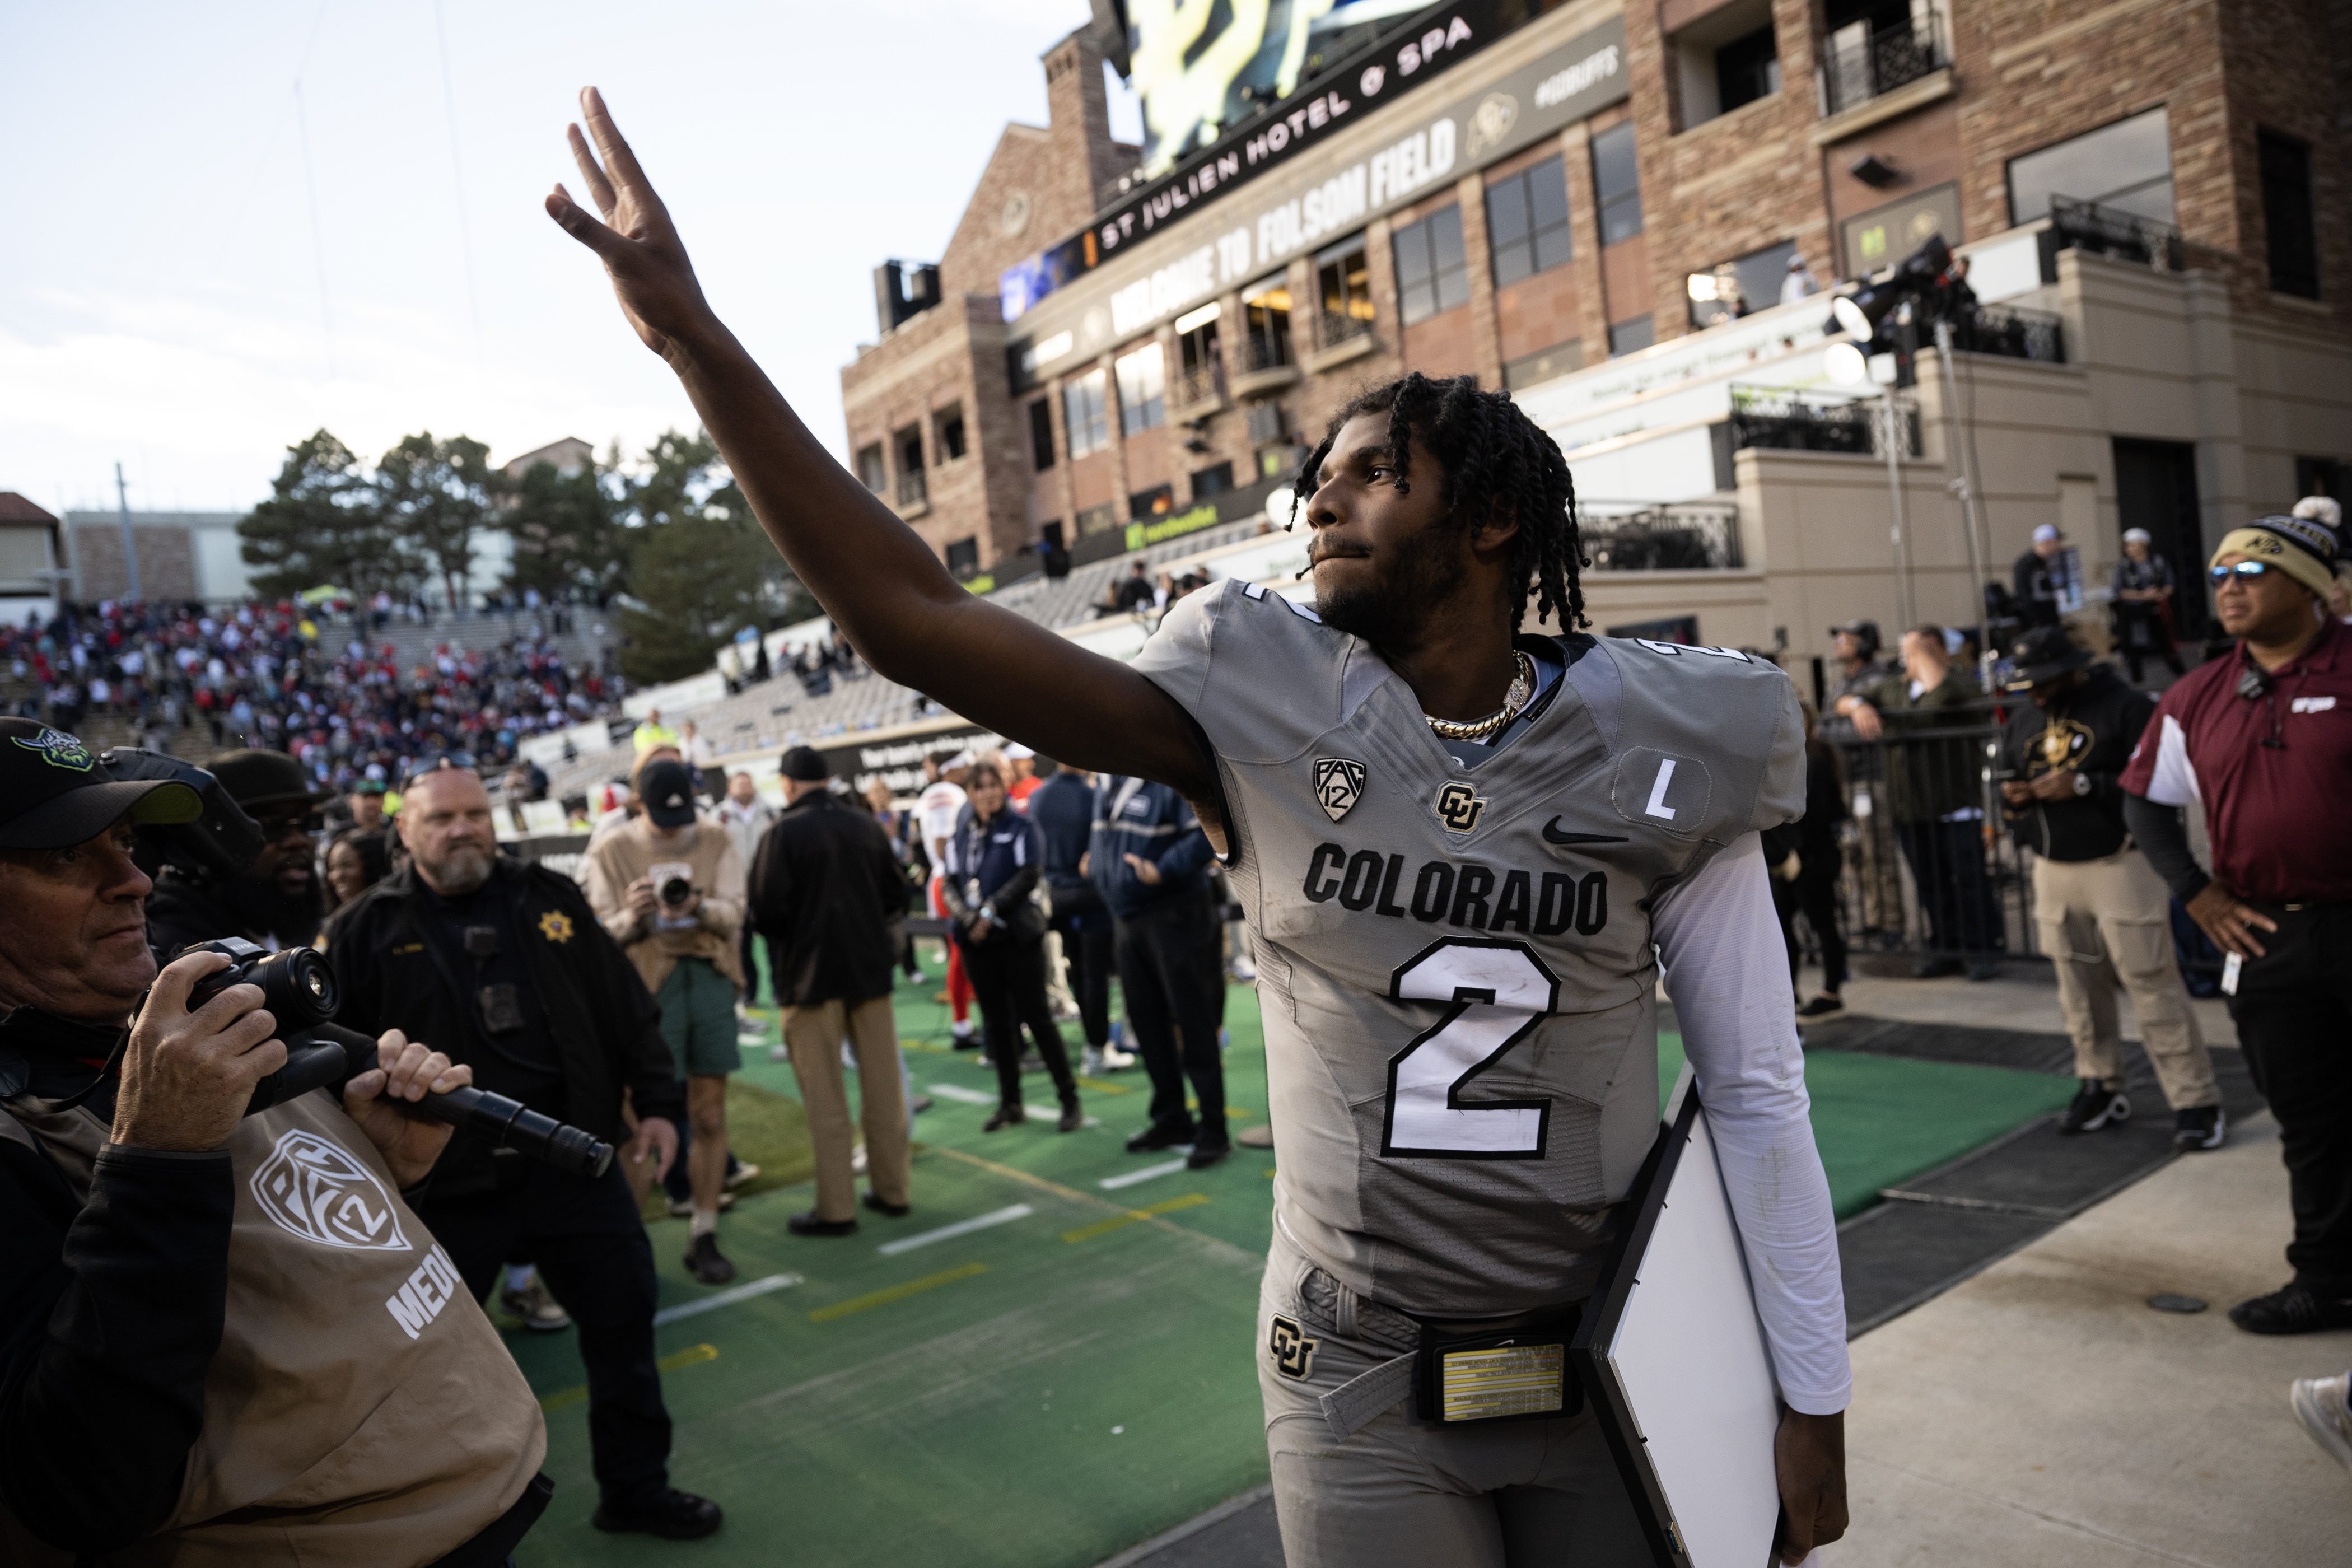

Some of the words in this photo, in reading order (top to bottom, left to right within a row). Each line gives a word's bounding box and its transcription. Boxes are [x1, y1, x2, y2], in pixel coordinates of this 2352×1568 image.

[1101, 212, 1135, 249] ST
[1143, 151, 1239, 230] JULIEN
[1247, 90, 1351, 166] HOTEL
[1397, 16, 1473, 77] SPA
[1111, 244, 1215, 336] WELCOME
[1216, 227, 1252, 281] TO
[1257, 163, 1368, 257] FOLSOM
[1370, 117, 1456, 208] FIELD
[1316, 760, 1365, 799] PAC
[1324, 786, 1350, 809] 12
[1434, 782, 1486, 833] CU
[1645, 759, 1676, 820] L
[1303, 842, 1608, 935] COLORADO
[1380, 935, 1562, 1159] 2
[332, 1194, 388, 1242] 12
[385, 1243, 461, 1340] MEDI
[1268, 1313, 1320, 1379] CU
